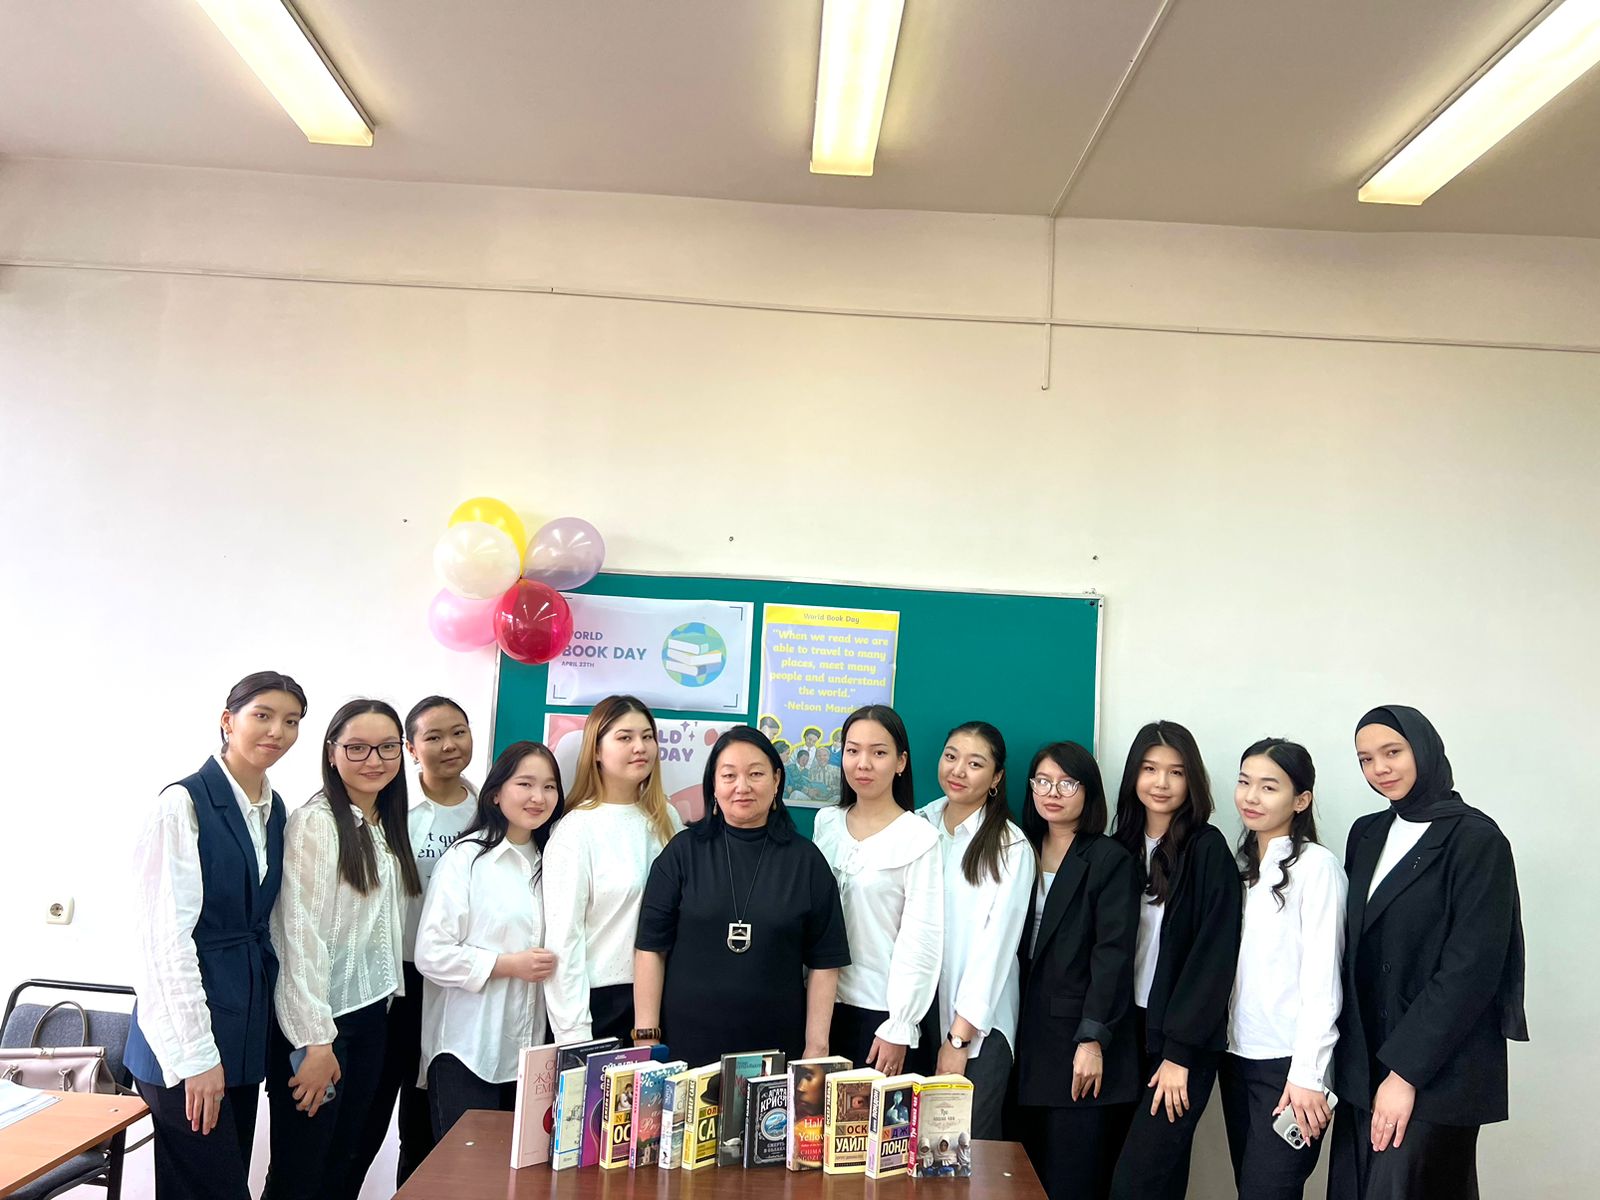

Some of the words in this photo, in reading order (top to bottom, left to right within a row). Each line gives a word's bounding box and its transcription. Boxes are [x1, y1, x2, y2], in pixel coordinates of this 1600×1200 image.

[845, 616, 860, 624] Day
[571, 631, 603, 641] ORLD
[810, 634, 825, 642] we
[828, 634, 851, 644] read
[854, 637, 869, 645] we
[872, 638, 888, 646] are
[562, 645, 608, 659] BOOK
[613, 646, 647, 661] DAY
[772, 643, 794, 653] able
[798, 645, 808, 654] to
[811, 646, 841, 656] travel
[844, 649, 855, 657] to
[857, 651, 886, 661] many
[781, 657, 816, 669] places,
[820, 661, 844, 670] meet
[847, 664, 877, 675] many
[769, 671, 802, 682] people
[805, 672, 825, 683] and
[828, 674, 886, 687] understand
[798, 686, 815, 696] the
[804, 1118, 824, 1128] Half
[882, 1139, 908, 1156] ЛОНД
